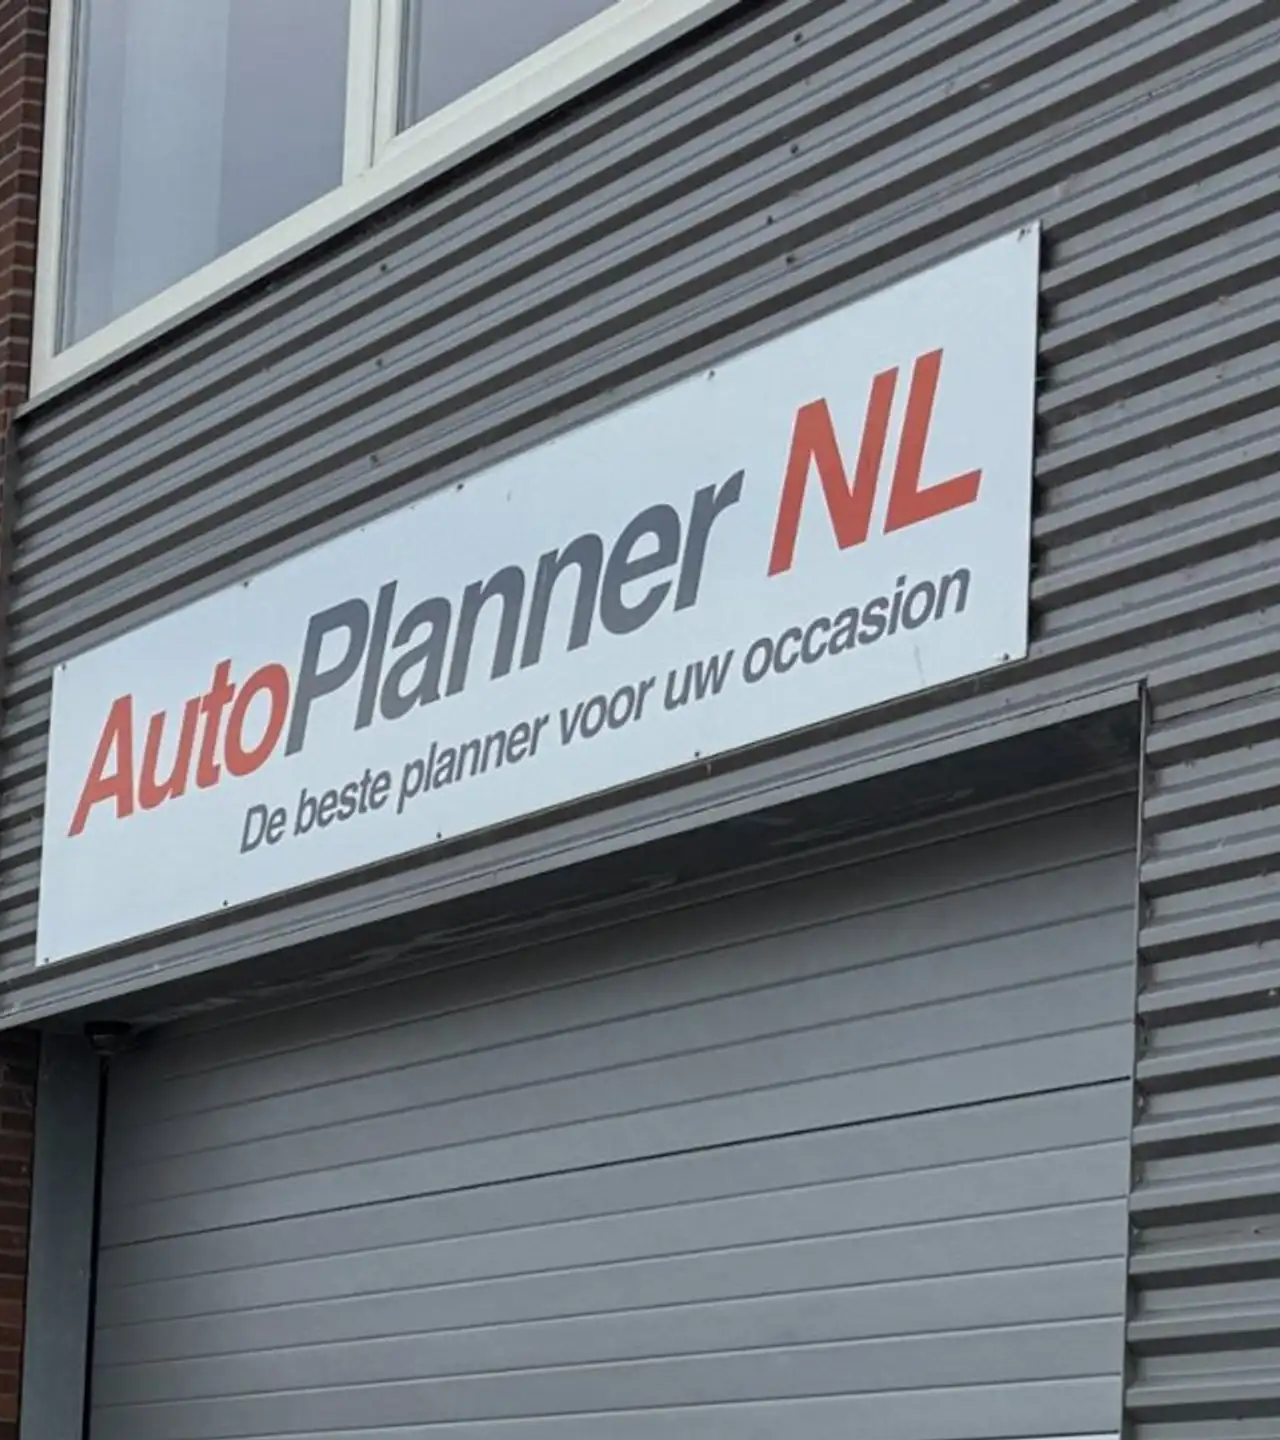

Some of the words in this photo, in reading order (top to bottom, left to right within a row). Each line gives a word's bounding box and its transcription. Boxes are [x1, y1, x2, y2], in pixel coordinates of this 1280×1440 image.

[68, 469, 744, 836] AutoPlanner
[767, 348, 982, 577] NL
[240, 804, 287, 854] De
[294, 768, 390, 836] beste
[397, 712, 548, 814] planner
[559, 676, 655, 746] voor
[664, 649, 734, 711] uw
[742, 567, 971, 684] occasion
